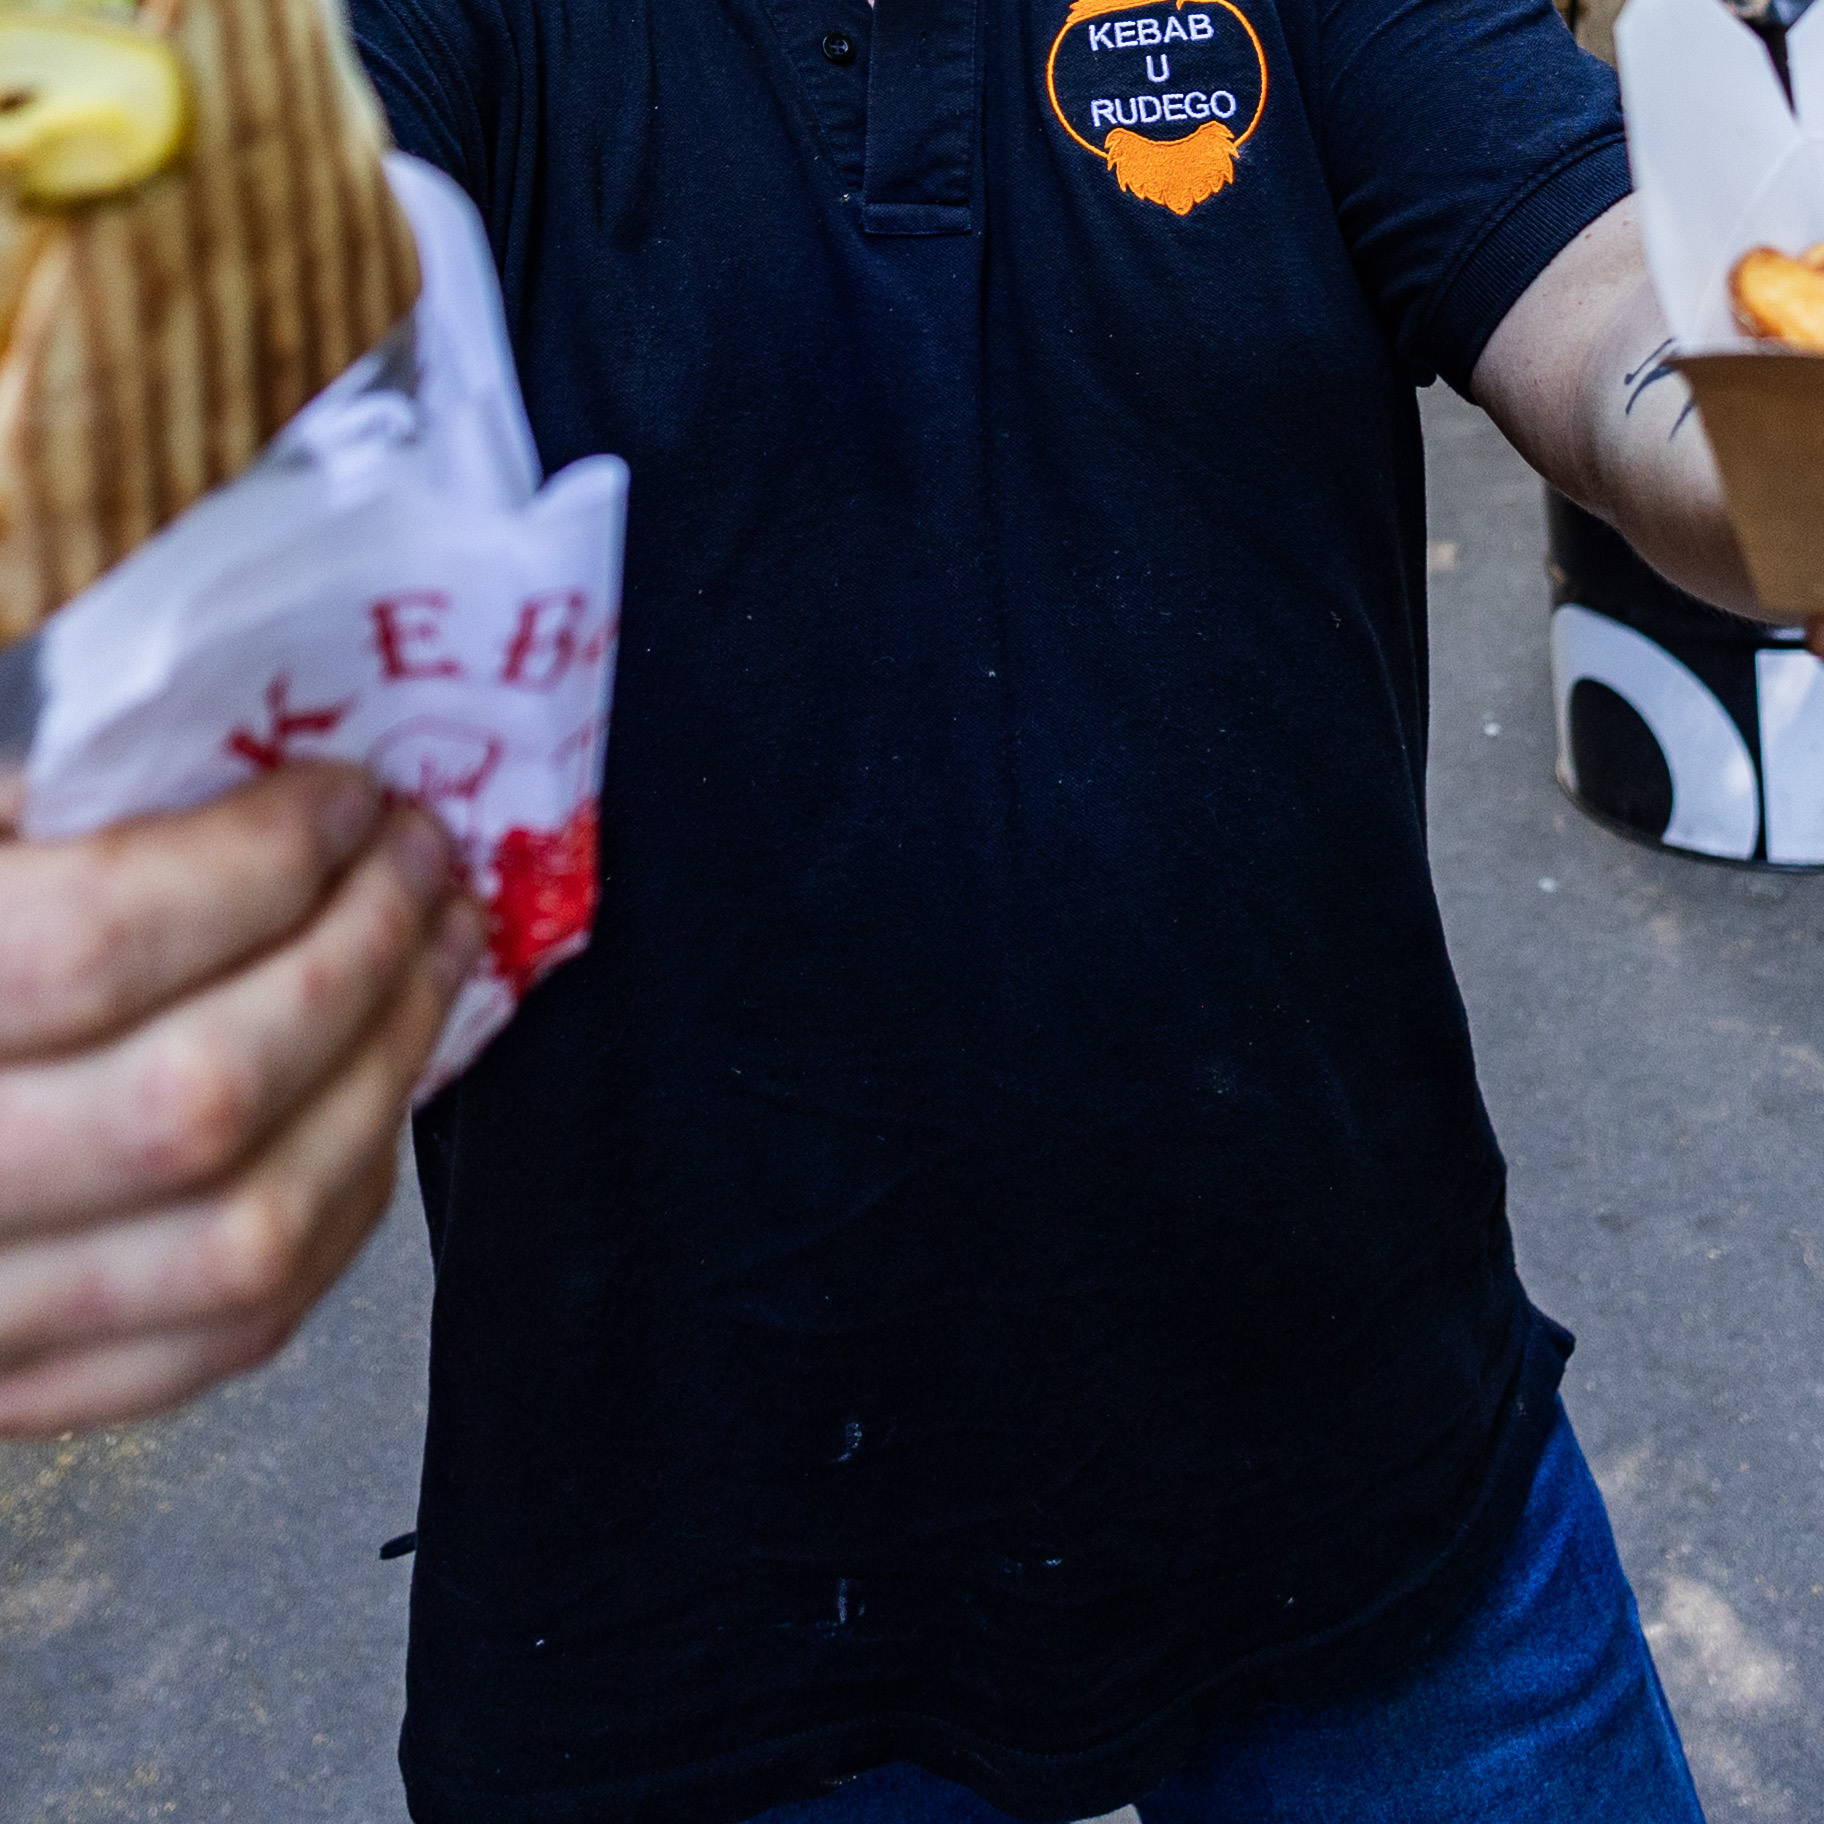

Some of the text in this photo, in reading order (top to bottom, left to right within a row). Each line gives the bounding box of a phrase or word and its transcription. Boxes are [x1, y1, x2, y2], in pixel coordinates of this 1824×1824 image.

[1088, 13, 1214, 51] KEBAB
[1146, 54, 1170, 83] U
[1090, 90, 1236, 127] RUDEGO
[225, 588, 618, 768] KEB
